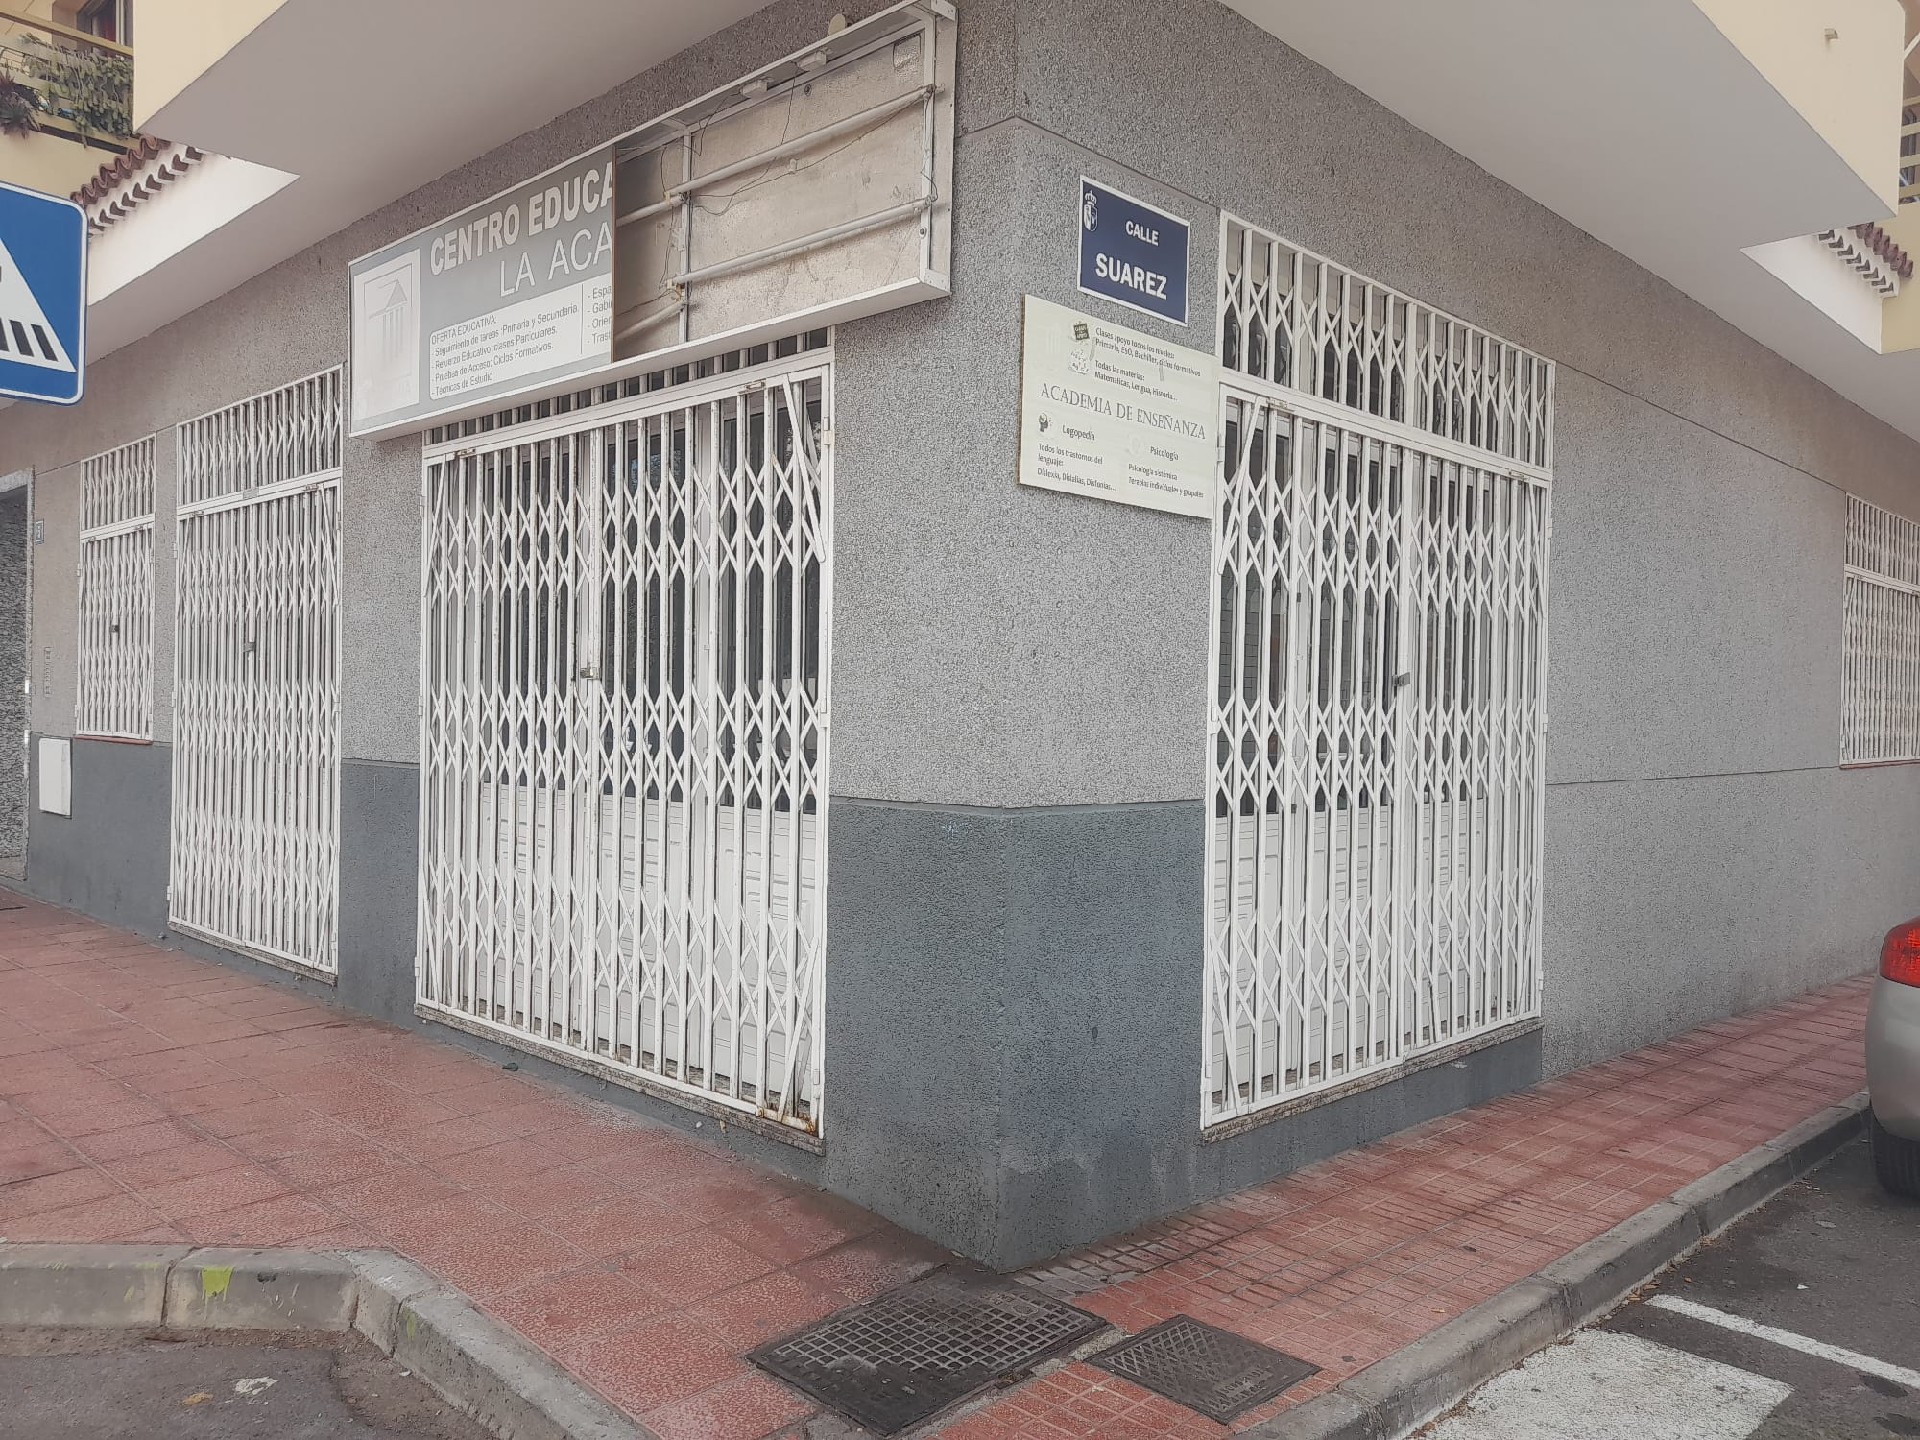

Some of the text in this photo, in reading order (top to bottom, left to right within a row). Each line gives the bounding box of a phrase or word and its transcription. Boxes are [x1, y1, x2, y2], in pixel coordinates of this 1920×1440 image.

[430, 162, 612, 276] CENTRO EDUCA
[1125, 220, 1158, 246] CALLE
[500, 222, 612, 297] LA ACA
[1095, 252, 1167, 300] SUAREZ
[431, 327, 457, 345] OFERTA
[1095, 327, 1114, 340] Clases
[494, 352, 513, 366] Ciclos
[1095, 360, 1112, 372] Todas
[461, 379, 468, 388] de
[1041, 383, 1206, 440] ACADEMIA DE ENSEÑANZA
[1062, 425, 1095, 441] Logopedia
[1039, 443, 1055, 454] Todos
